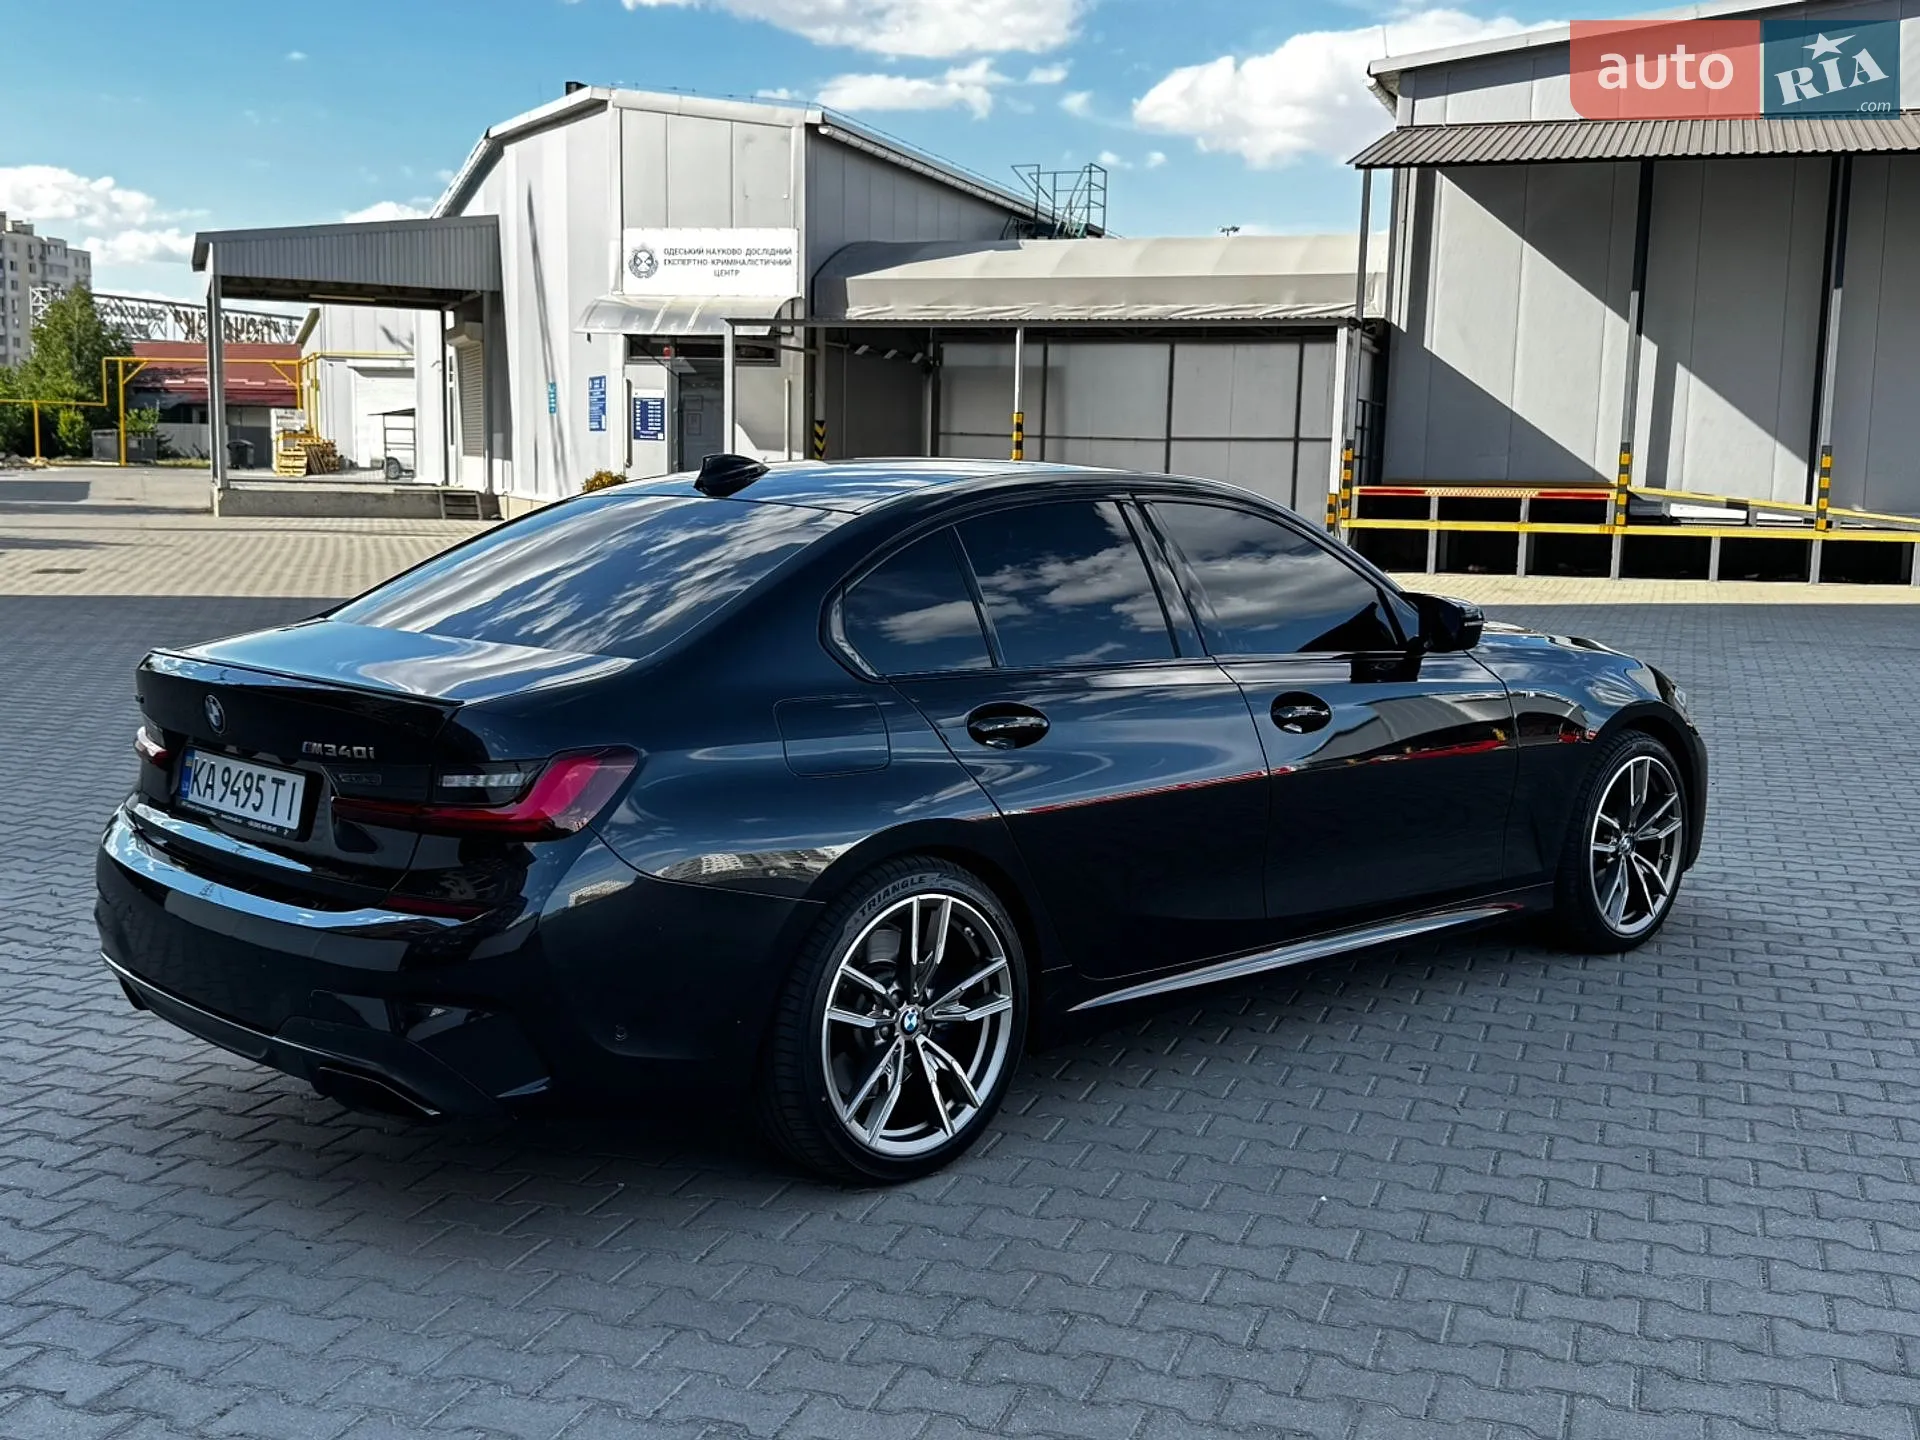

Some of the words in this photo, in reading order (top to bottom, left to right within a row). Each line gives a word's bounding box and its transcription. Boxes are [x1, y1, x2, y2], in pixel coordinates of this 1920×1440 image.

[663, 246, 704, 256] ОДЕСЬКИЙ
[713, 269, 741, 277] ЦЕНТР
[860, 875, 927, 917] TRIANGLE
